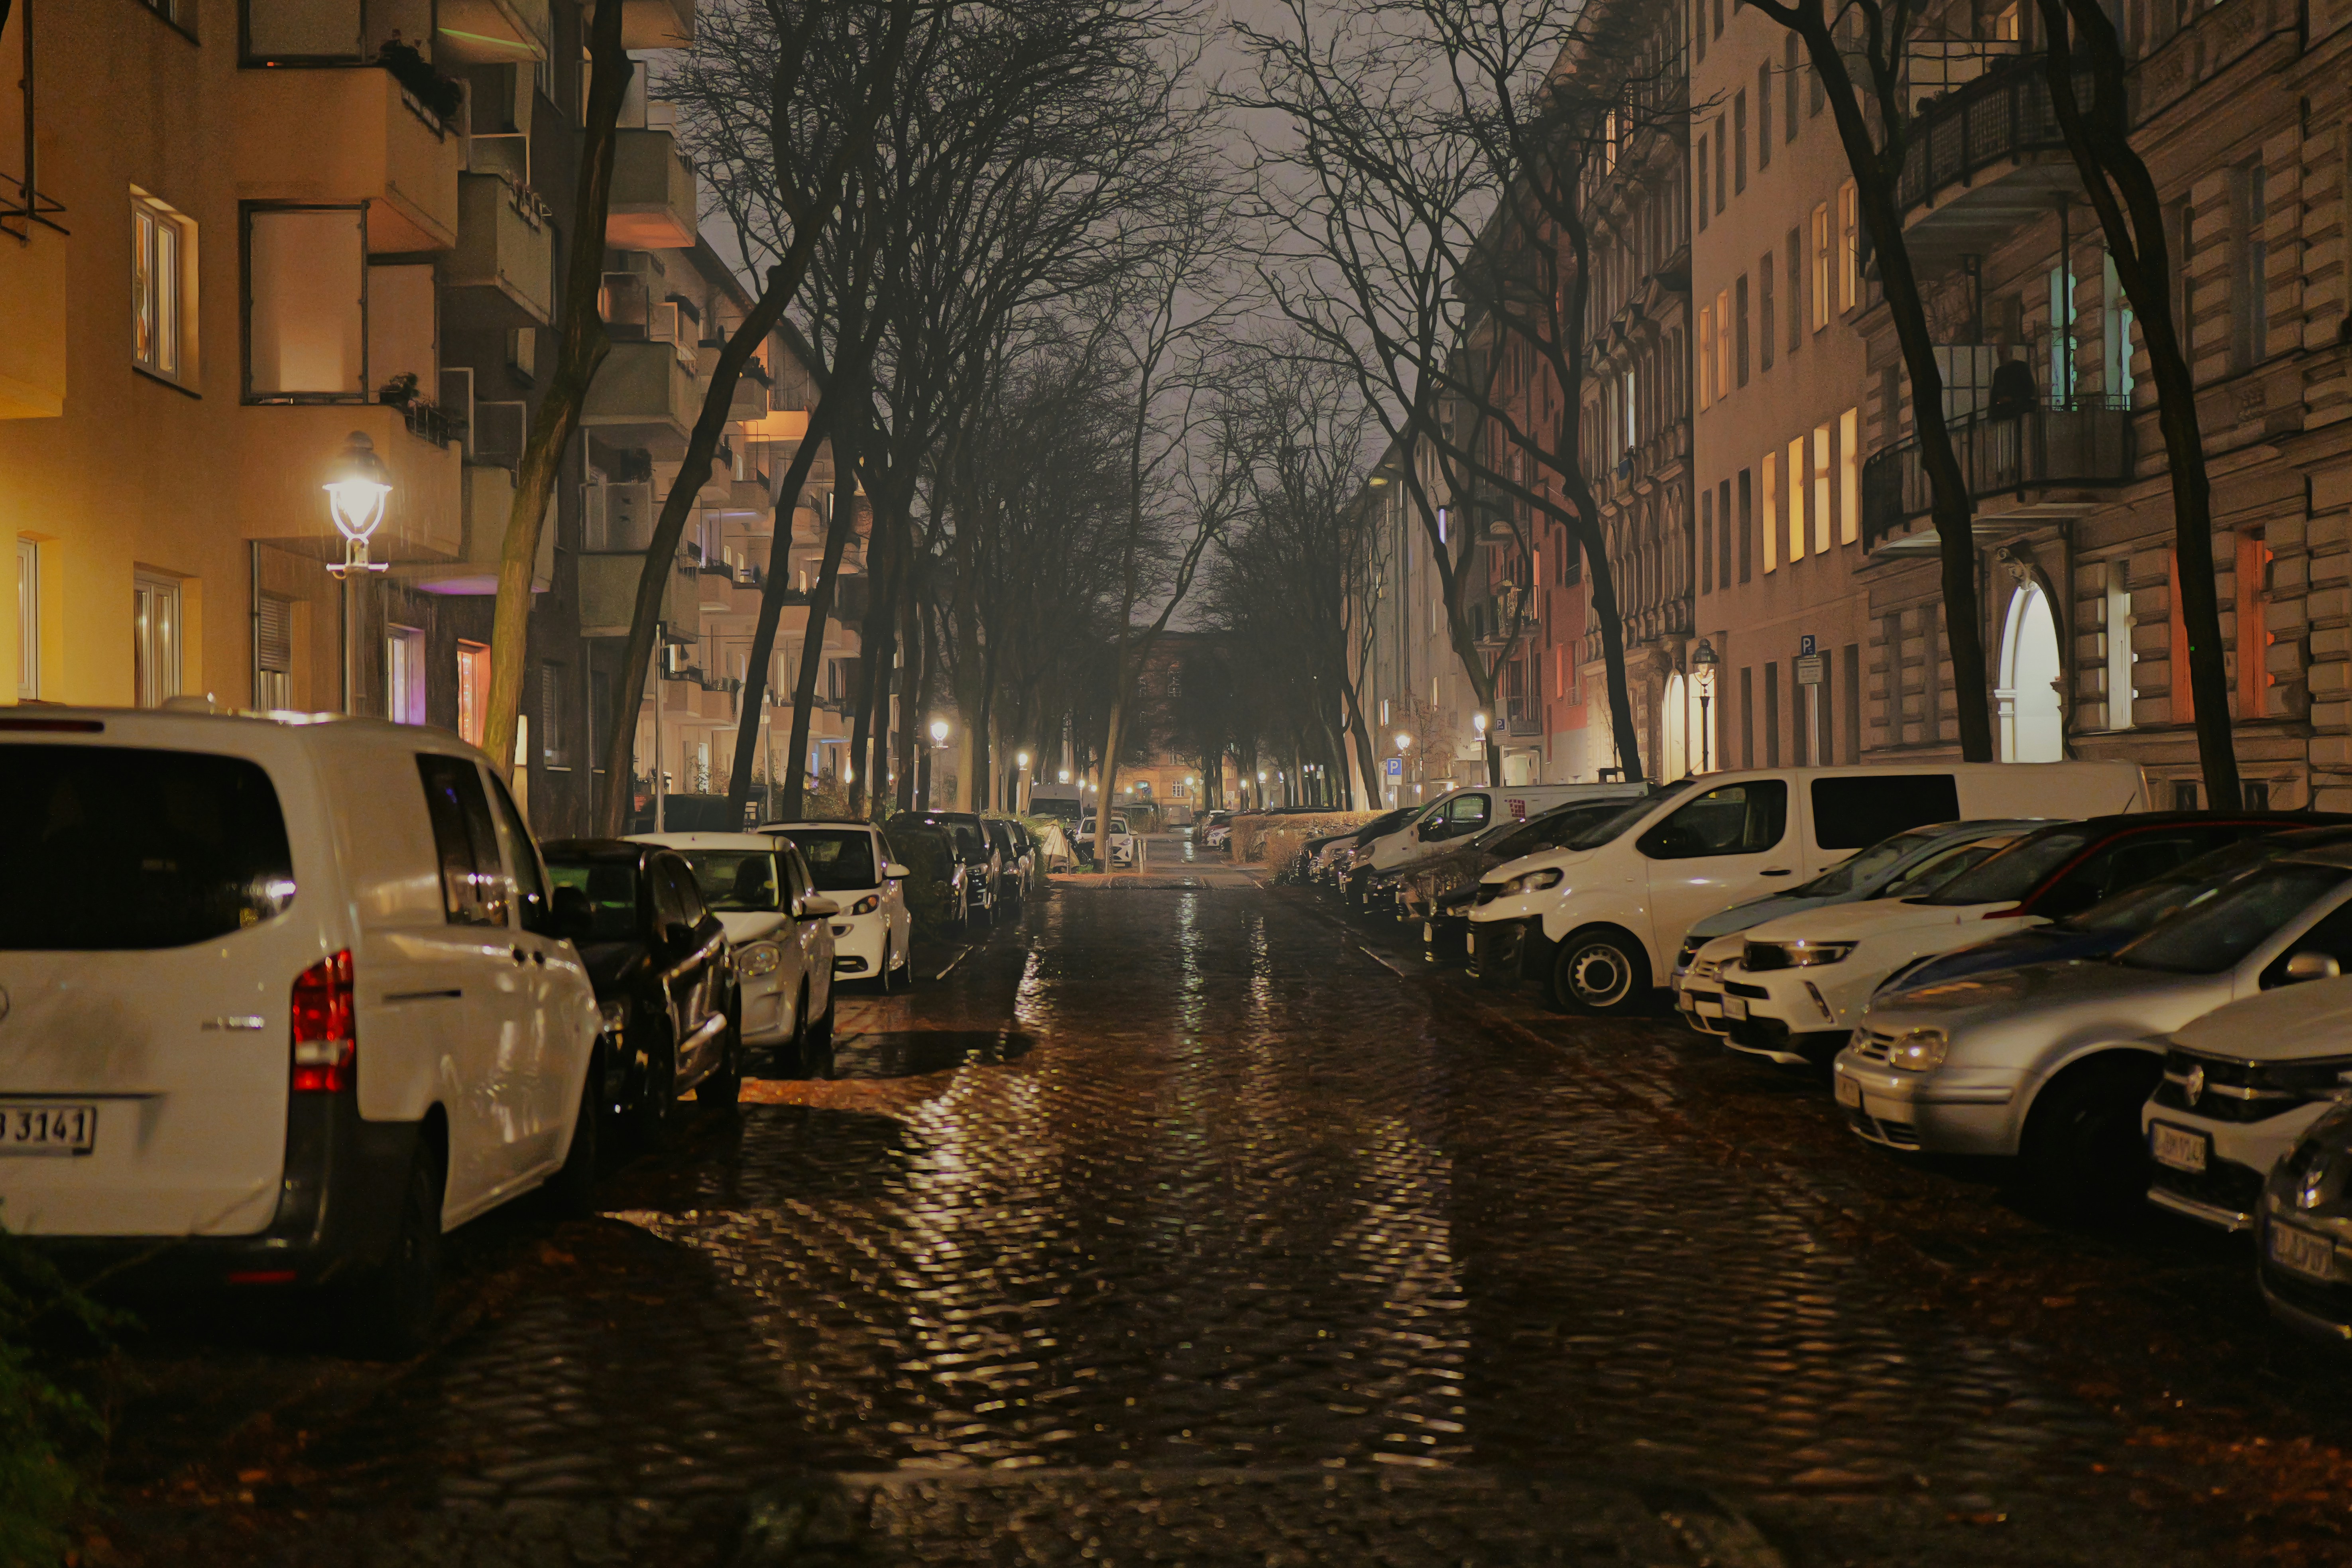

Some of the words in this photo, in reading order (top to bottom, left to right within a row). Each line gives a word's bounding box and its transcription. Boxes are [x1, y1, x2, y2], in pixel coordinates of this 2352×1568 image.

[1803, 637, 1811, 653] P
[1497, 720, 1502, 729] P
[1390, 761, 1398, 774] P
[15, 1112, 84, 1141] 3141
